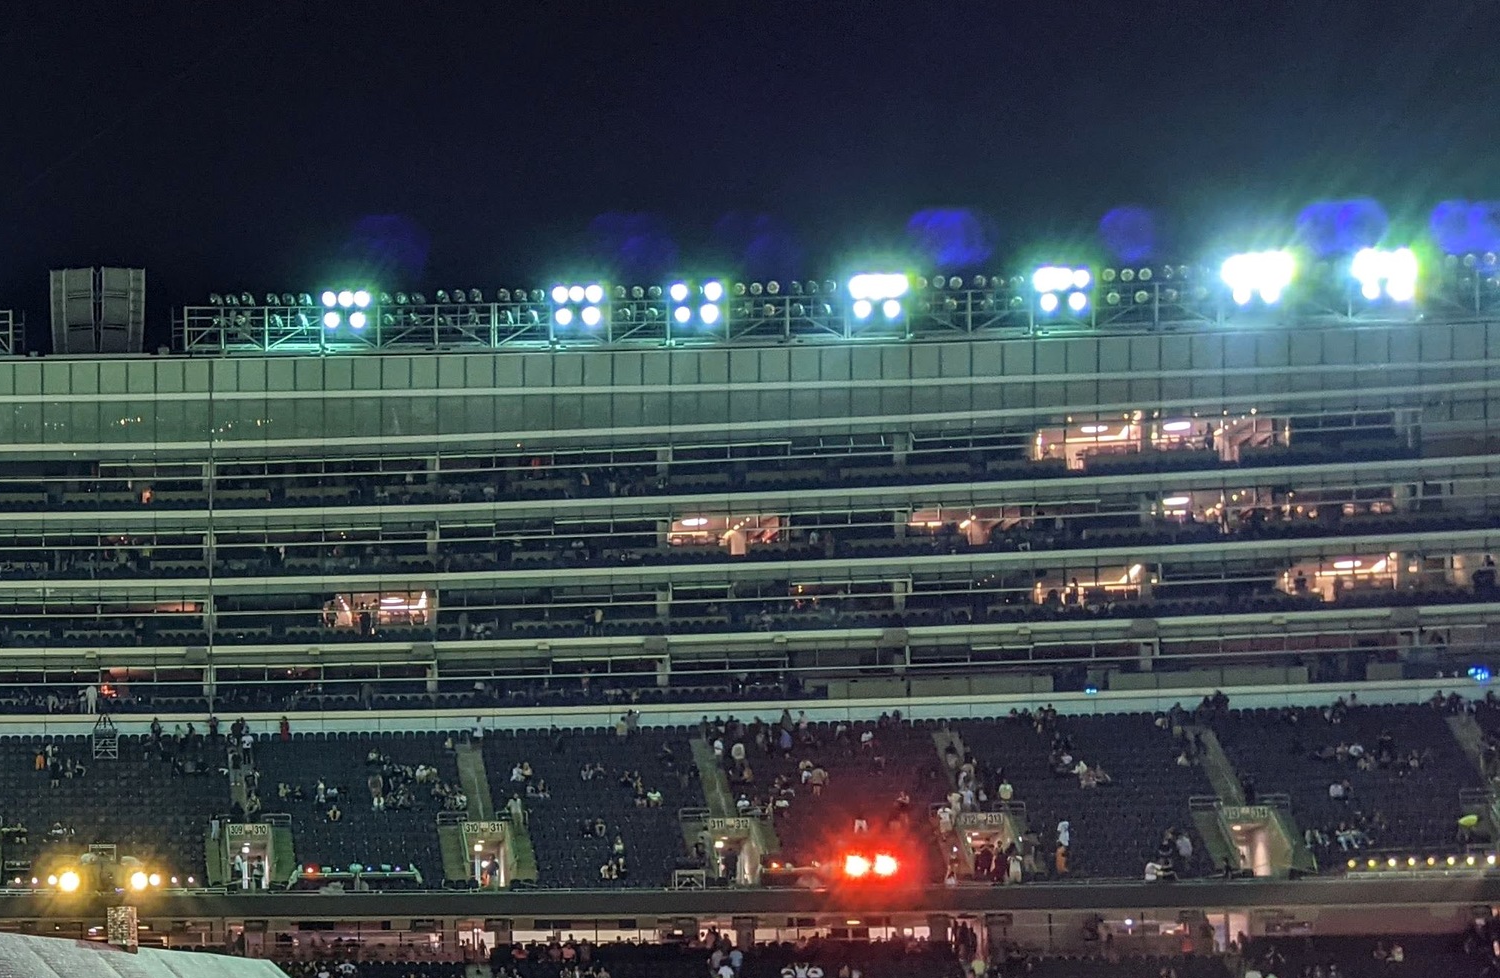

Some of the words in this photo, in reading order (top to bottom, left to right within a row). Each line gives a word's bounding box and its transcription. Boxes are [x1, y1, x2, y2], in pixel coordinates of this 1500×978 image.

[254, 825, 267, 834] 310
[465, 823, 478, 832] 310
[490, 822, 503, 832] 311
